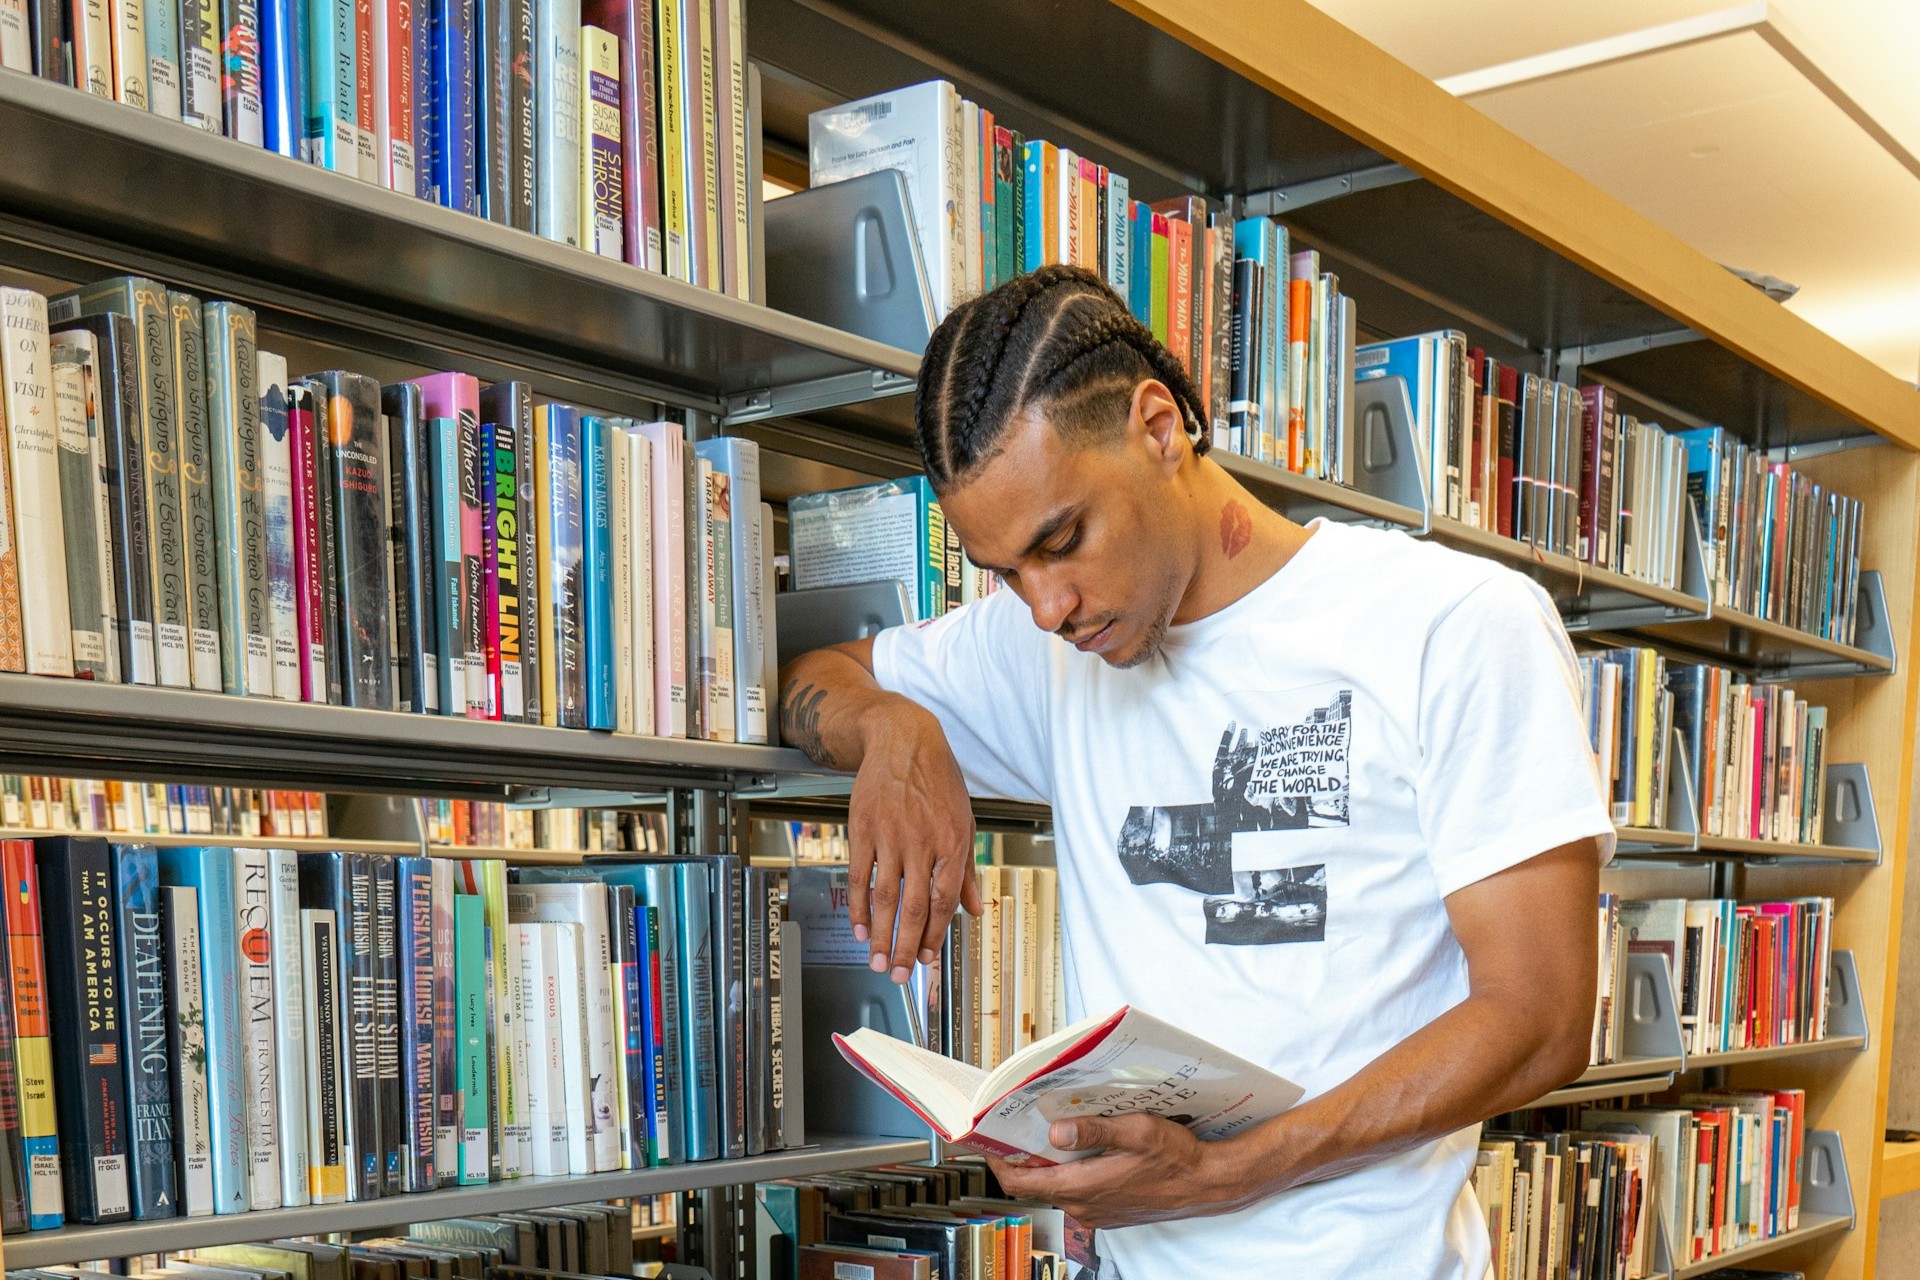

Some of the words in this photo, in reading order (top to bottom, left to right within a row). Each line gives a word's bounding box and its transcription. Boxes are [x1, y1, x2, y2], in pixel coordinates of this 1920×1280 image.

[522, 0, 532, 42] rfect
[361, 30, 371, 92] Goldberg
[401, 45, 410, 106] Goldberg
[592, 75, 605, 85] NEW
[605, 78, 619, 90] YORK
[598, 85, 614, 95] TIMES
[702, 46, 713, 124] ABYSSINIAN
[733, 61, 744, 137] ABYSSINIAN
[522, 97, 532, 150] Susan
[592, 103, 619, 123] SUSAN
[642, 69, 657, 167] CONTROL
[667, 85, 675, 134] backbeat
[593, 120, 620, 139] ISAACS
[891, 141, 902, 149] and
[903, 138, 916, 146] Posh
[523, 154, 532, 207] Isaacs
[705, 131, 716, 213] CHRONICLES
[735, 144, 746, 224] CHRONICLES
[1116, 210, 1125, 247] YADA
[1116, 250, 1125, 285] YADA
[1177, 260, 1189, 294] YADA
[5, 315, 47, 335] THERE
[1177, 297, 1188, 330] YADA
[19, 338, 39, 353] ON
[26, 362, 35, 375] A
[14, 382, 48, 399] VISIT
[522, 393, 530, 430] ALAN
[14, 424, 55, 440] Christopher
[304, 426, 311, 434] A
[354, 441, 363, 449] THE
[16, 440, 54, 456] Isherwood
[304, 444, 313, 478] PALE
[335, 450, 378, 466] UNCONSOLED
[458, 409, 481, 506] Motherest
[523, 433, 532, 470] ISLER
[345, 466, 373, 479] KAZUO
[594, 445, 606, 489] KRAVEN
[307, 486, 315, 522] VIEW
[339, 479, 378, 494] ISHIGURO
[495, 450, 519, 588] BRIGHT
[596, 490, 607, 528] IMAGES
[622, 517, 627, 530] OF
[309, 528, 316, 547] OF
[311, 553, 319, 596] HILLS
[525, 531, 535, 588] BACON
[707, 540, 716, 604] ROCKAWAY
[717, 550, 726, 591] Recipe
[451, 577, 459, 595] Fazil
[720, 594, 728, 623] Club
[161, 626, 179, 635] Fiction
[161, 634, 184, 643] ISHIGUR
[527, 595, 538, 665] FANCIER
[564, 617, 576, 671] ISLER
[673, 628, 682, 673] ISON
[1260, 725, 1291, 745] SORRY
[1292, 724, 1320, 735] FOR
[1322, 722, 1347, 734] THE
[1260, 735, 1344, 757] INCONVENIENCE
[1256, 769, 1272, 777] TO
[1277, 765, 1326, 777] CHANGE
[1260, 758, 1279, 769] WE
[1279, 753, 1298, 769] ARE
[1299, 749, 1344, 763] TRYING
[1251, 779, 1278, 794] THE
[1282, 777, 1341, 794] WORLD
[81, 870, 90, 896] THAT
[96, 872, 107, 888] IT
[353, 874, 369, 907] MARC
[377, 879, 394, 912] MARC
[411, 873, 432, 959] PERSIAN
[731, 867, 741, 934] EUGENE
[767, 887, 780, 947] EUGENE
[82, 914, 95, 940] AM
[98, 896, 112, 969] OCCURS
[239, 864, 273, 1024] REQUIEM
[353, 911, 370, 956] IVERSON
[377, 915, 395, 959] IVERSON
[190, 928, 199, 1002] REMEMBERING
[321, 935, 329, 985] VSEVOLOD
[434, 952, 454, 968] IVES
[600, 933, 608, 972] ABANDON
[732, 935, 741, 970] IZZI
[769, 949, 781, 980] IZZI
[85, 948, 101, 1032] AMERICA
[103, 976, 113, 999] TO
[503, 968, 507, 979] NO
[992, 950, 1000, 995] LOVE
[20, 995, 34, 1003] War
[132, 911, 169, 1075] DEAFENING
[323, 987, 331, 1024] IVANOV
[352, 976, 374, 1015] FIRE
[376, 979, 398, 1017] FIRE
[414, 965, 433, 1028] HORSE
[547, 976, 556, 1019] EXODUS
[104, 1007, 115, 1031] ME
[770, 993, 782, 1046] TRIBAL
[325, 1033, 333, 1080] FERTILITY
[354, 1022, 376, 1079] STORM
[378, 1024, 399, 1079] STORM
[417, 1043, 433, 1088] MARC
[654, 1054, 662, 1079] CUBA
[25, 1078, 45, 1087] Steve
[26, 1091, 46, 1100] Israel
[257, 1039, 271, 1118] FRANCES
[771, 1048, 783, 1110] SECRETS
[1097, 1063, 1198, 1118] POSITE
[136, 1102, 172, 1118] FRANCE
[1103, 1090, 1128, 1103] The
[1143, 1088, 1198, 1115] ATE
[1222, 1091, 1254, 1114] Humanity
[137, 1116, 172, 1141] ITAN
[261, 1125, 274, 1148] ITA
[418, 1092, 434, 1157] IVERSON
[414, 1222, 477, 1244] HAMMOND
